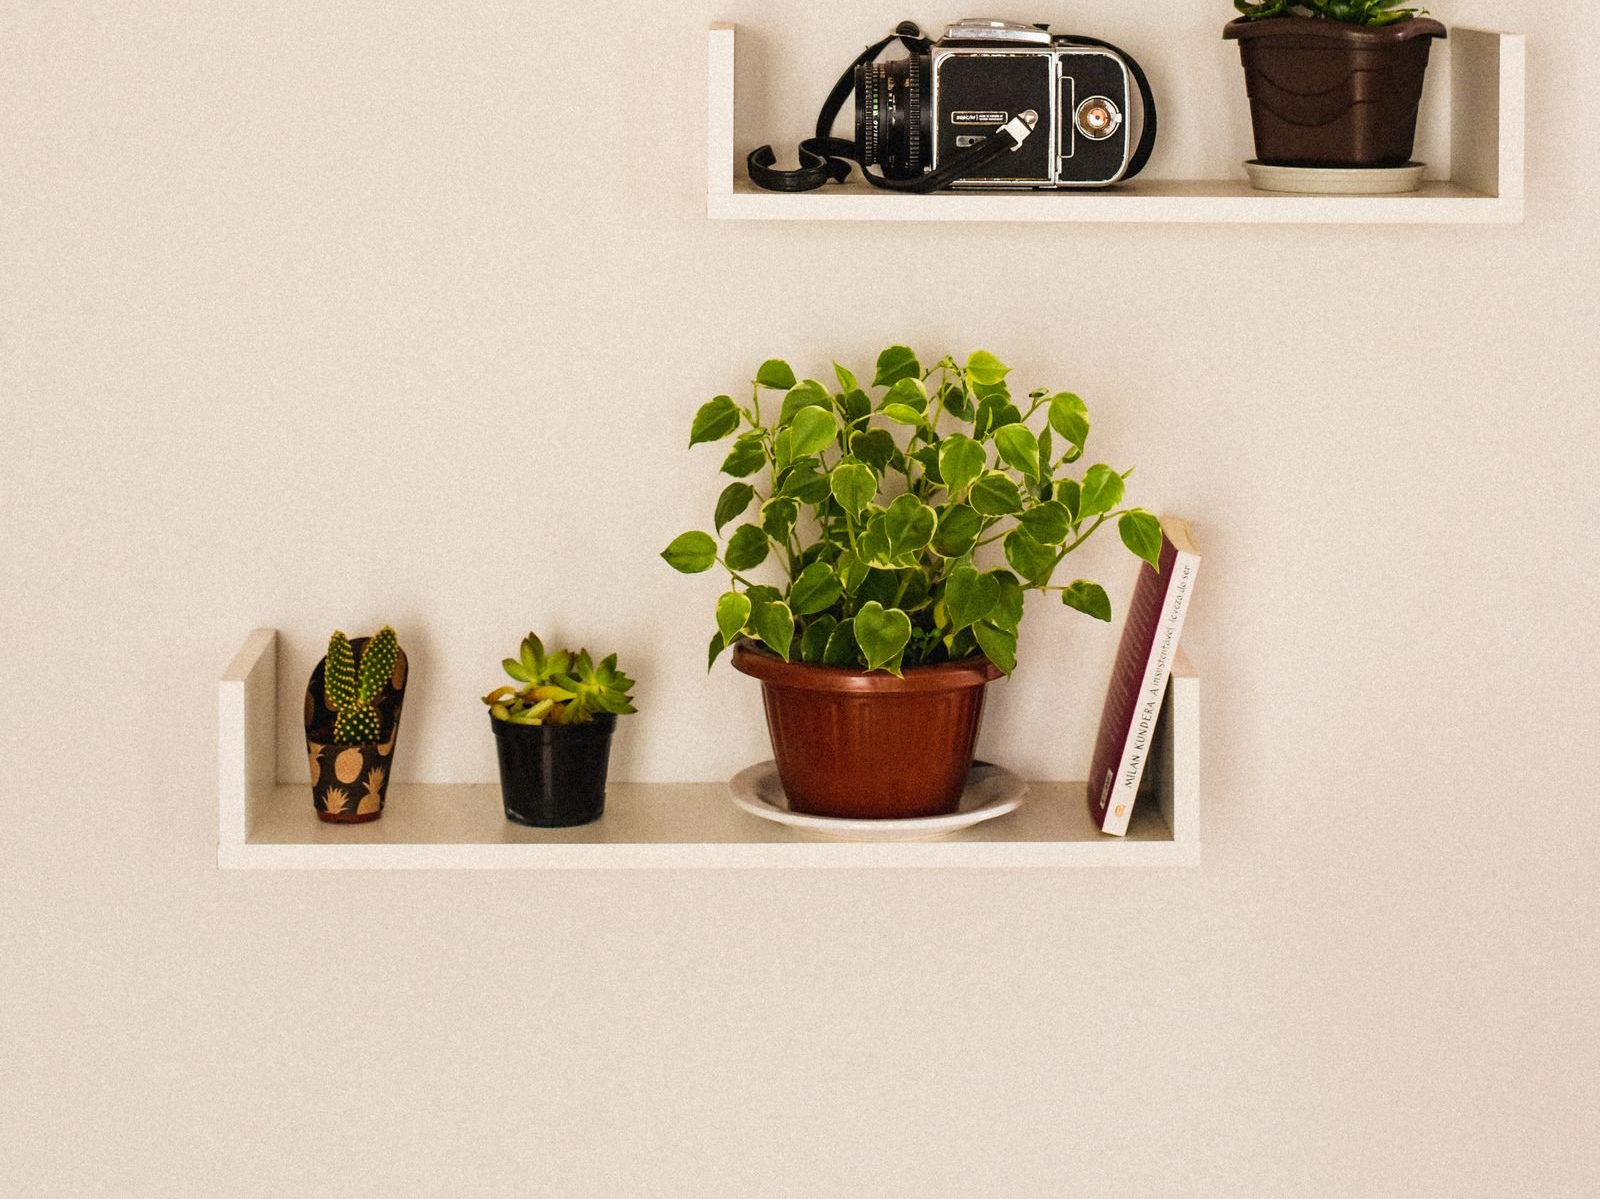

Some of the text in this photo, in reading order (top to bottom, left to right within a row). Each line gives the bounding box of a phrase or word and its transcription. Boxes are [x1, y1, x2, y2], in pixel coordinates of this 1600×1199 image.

[1125, 755, 1140, 788] MILAN
[1135, 701, 1156, 750] KUNDERA
[1149, 688, 1159, 697] A
[1182, 565, 1191, 579] ser
